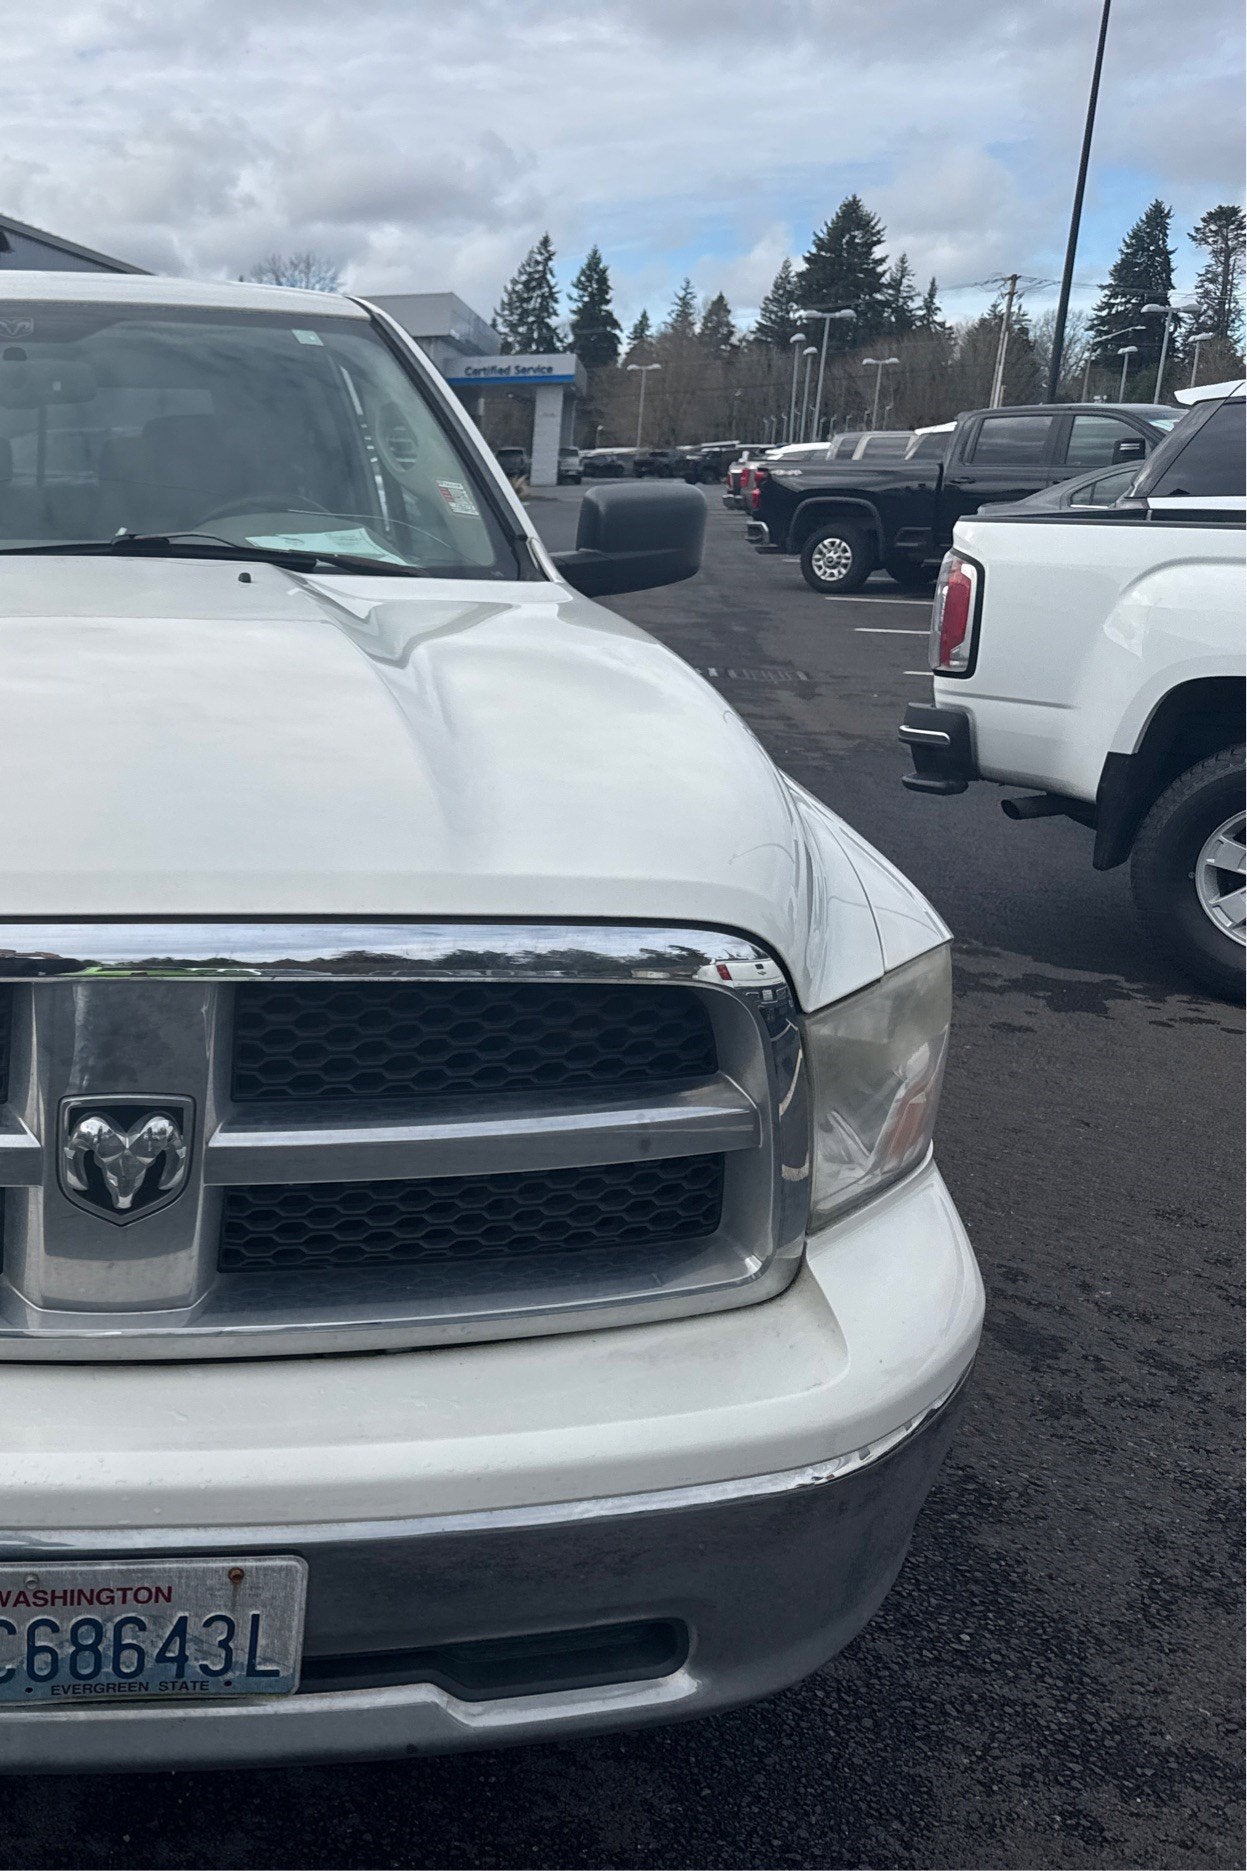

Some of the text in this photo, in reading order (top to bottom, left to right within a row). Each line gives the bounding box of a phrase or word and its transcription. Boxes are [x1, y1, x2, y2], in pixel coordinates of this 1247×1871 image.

[465, 365, 553, 376] Certified Service
[51, 1680, 210, 1696] EVERGREEN STATE
